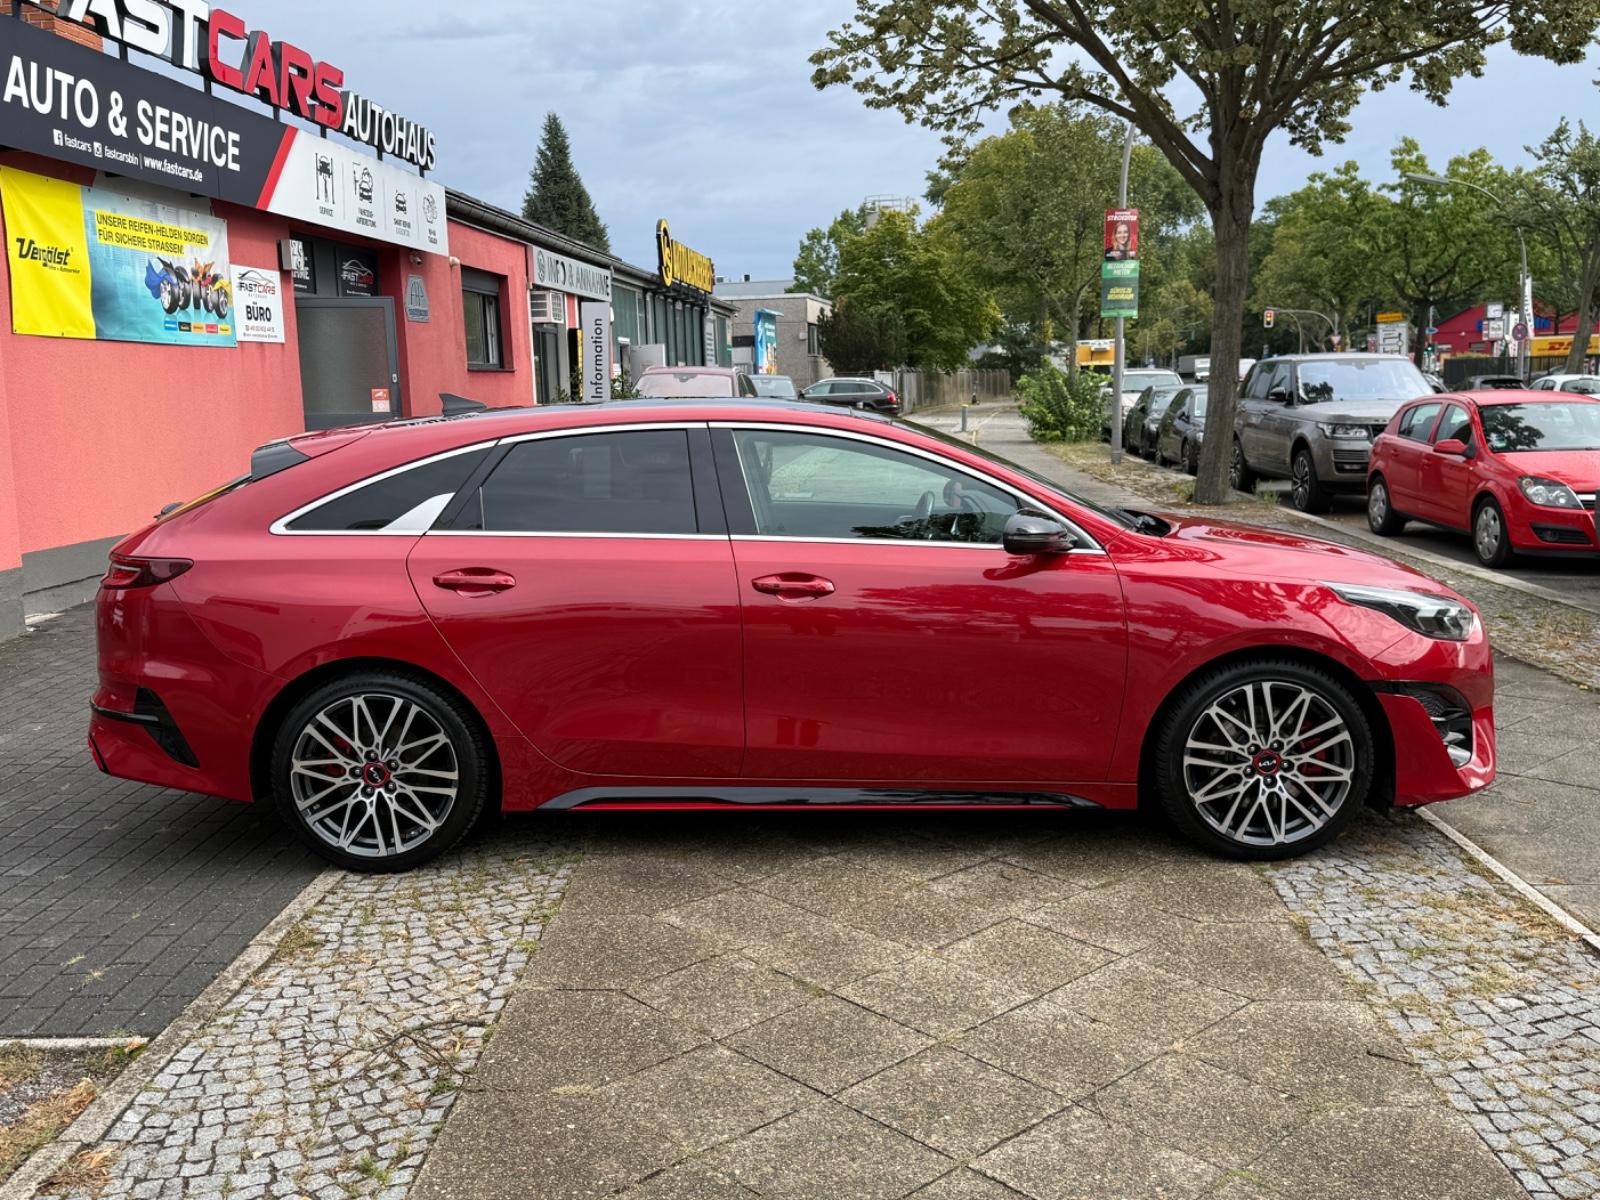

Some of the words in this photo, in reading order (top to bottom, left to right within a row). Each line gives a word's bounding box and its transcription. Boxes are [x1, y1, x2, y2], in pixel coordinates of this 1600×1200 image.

[3, 55, 99, 128] AUTO
[107, 90, 128, 140] &
[137, 99, 241, 171] SERVICE
[344, 92, 437, 171] AUTOHAUS
[64, 133, 92, 153] fastcars
[143, 155, 203, 182] www.fastcars.de
[96, 212, 127, 230] UNSERE
[128, 219, 183, 241] REIFEN-HELDEN
[183, 231, 209, 246] SORGEN
[98, 227, 113, 241] FÜR
[115, 232, 147, 248] SICHERE
[16, 236, 71, 267] Vergölst
[238, 282, 276, 295] FASTCARS
[245, 301, 272, 322] BÜRO
[590, 317, 603, 399] Information
